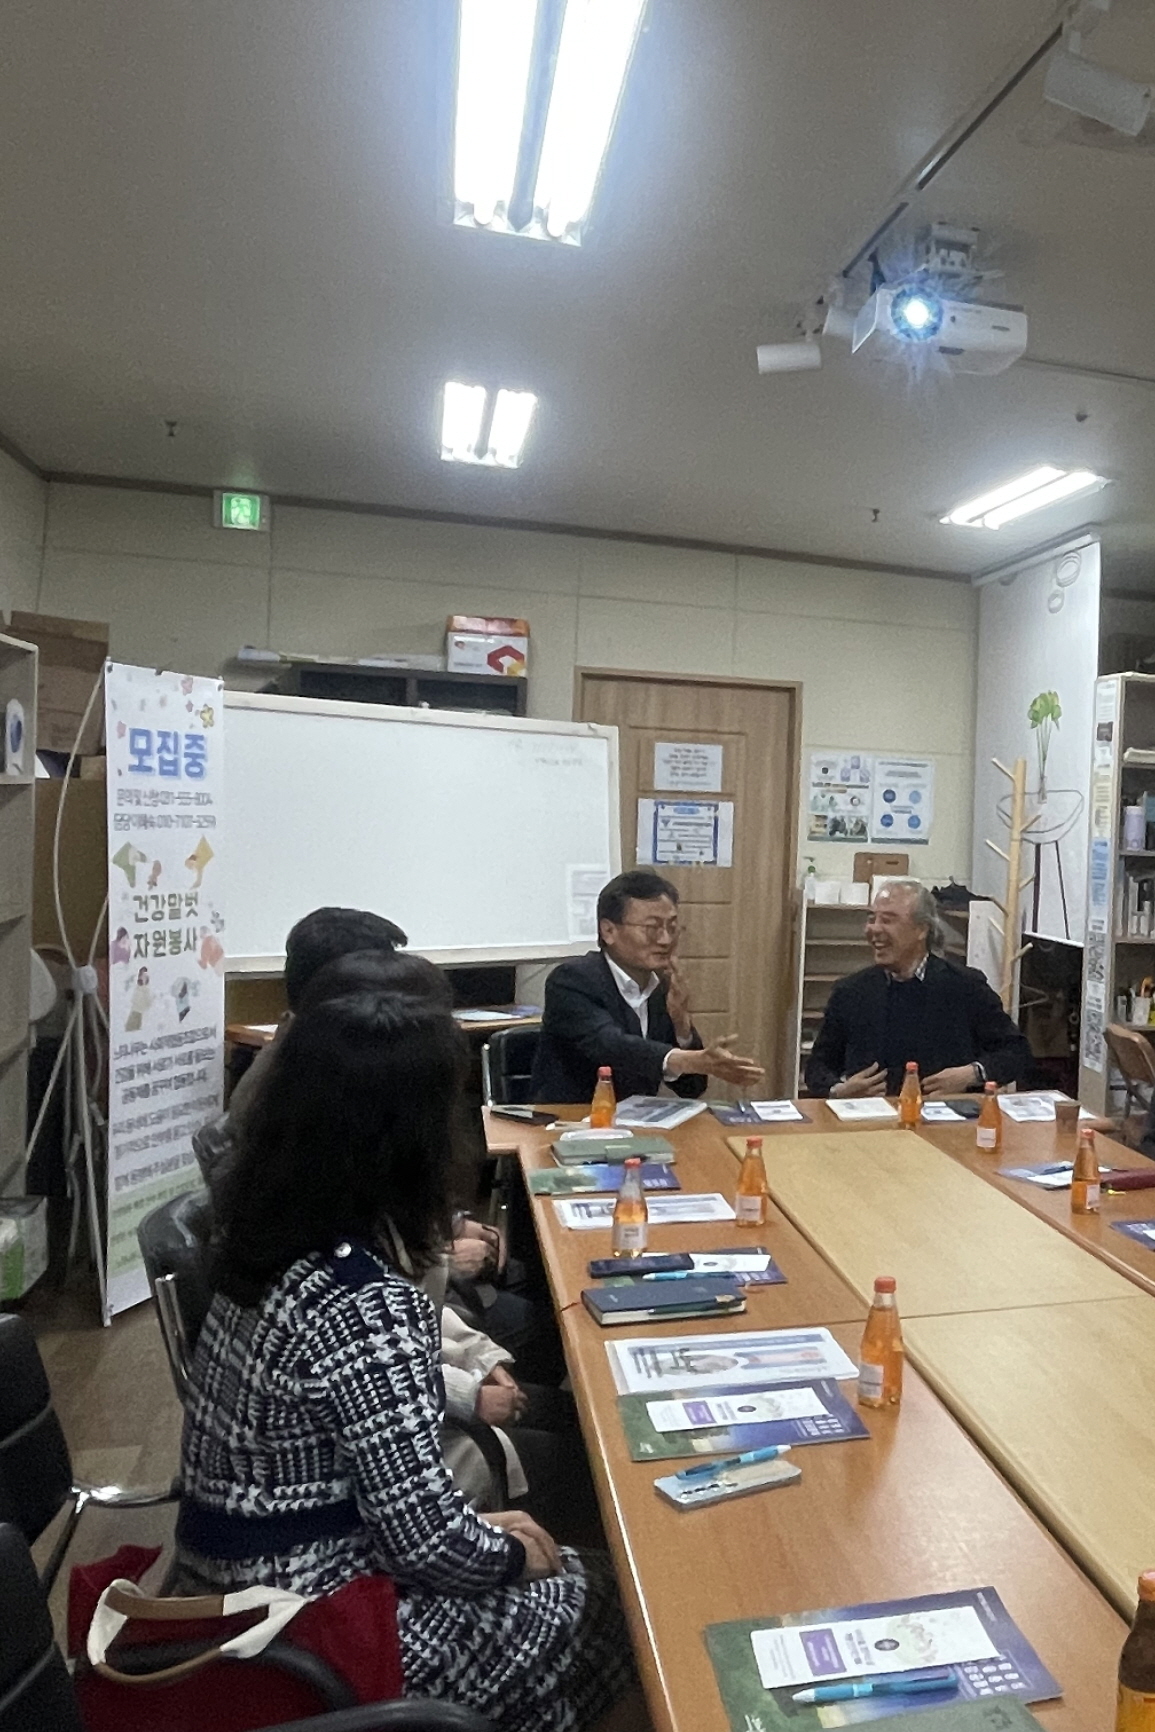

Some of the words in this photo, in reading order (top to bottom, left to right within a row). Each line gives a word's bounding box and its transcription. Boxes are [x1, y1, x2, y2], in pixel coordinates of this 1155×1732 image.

[128, 727, 207, 779] 모집중
[132, 892, 199, 923] 건강말벗
[133, 926, 197, 959] 자원봉사
